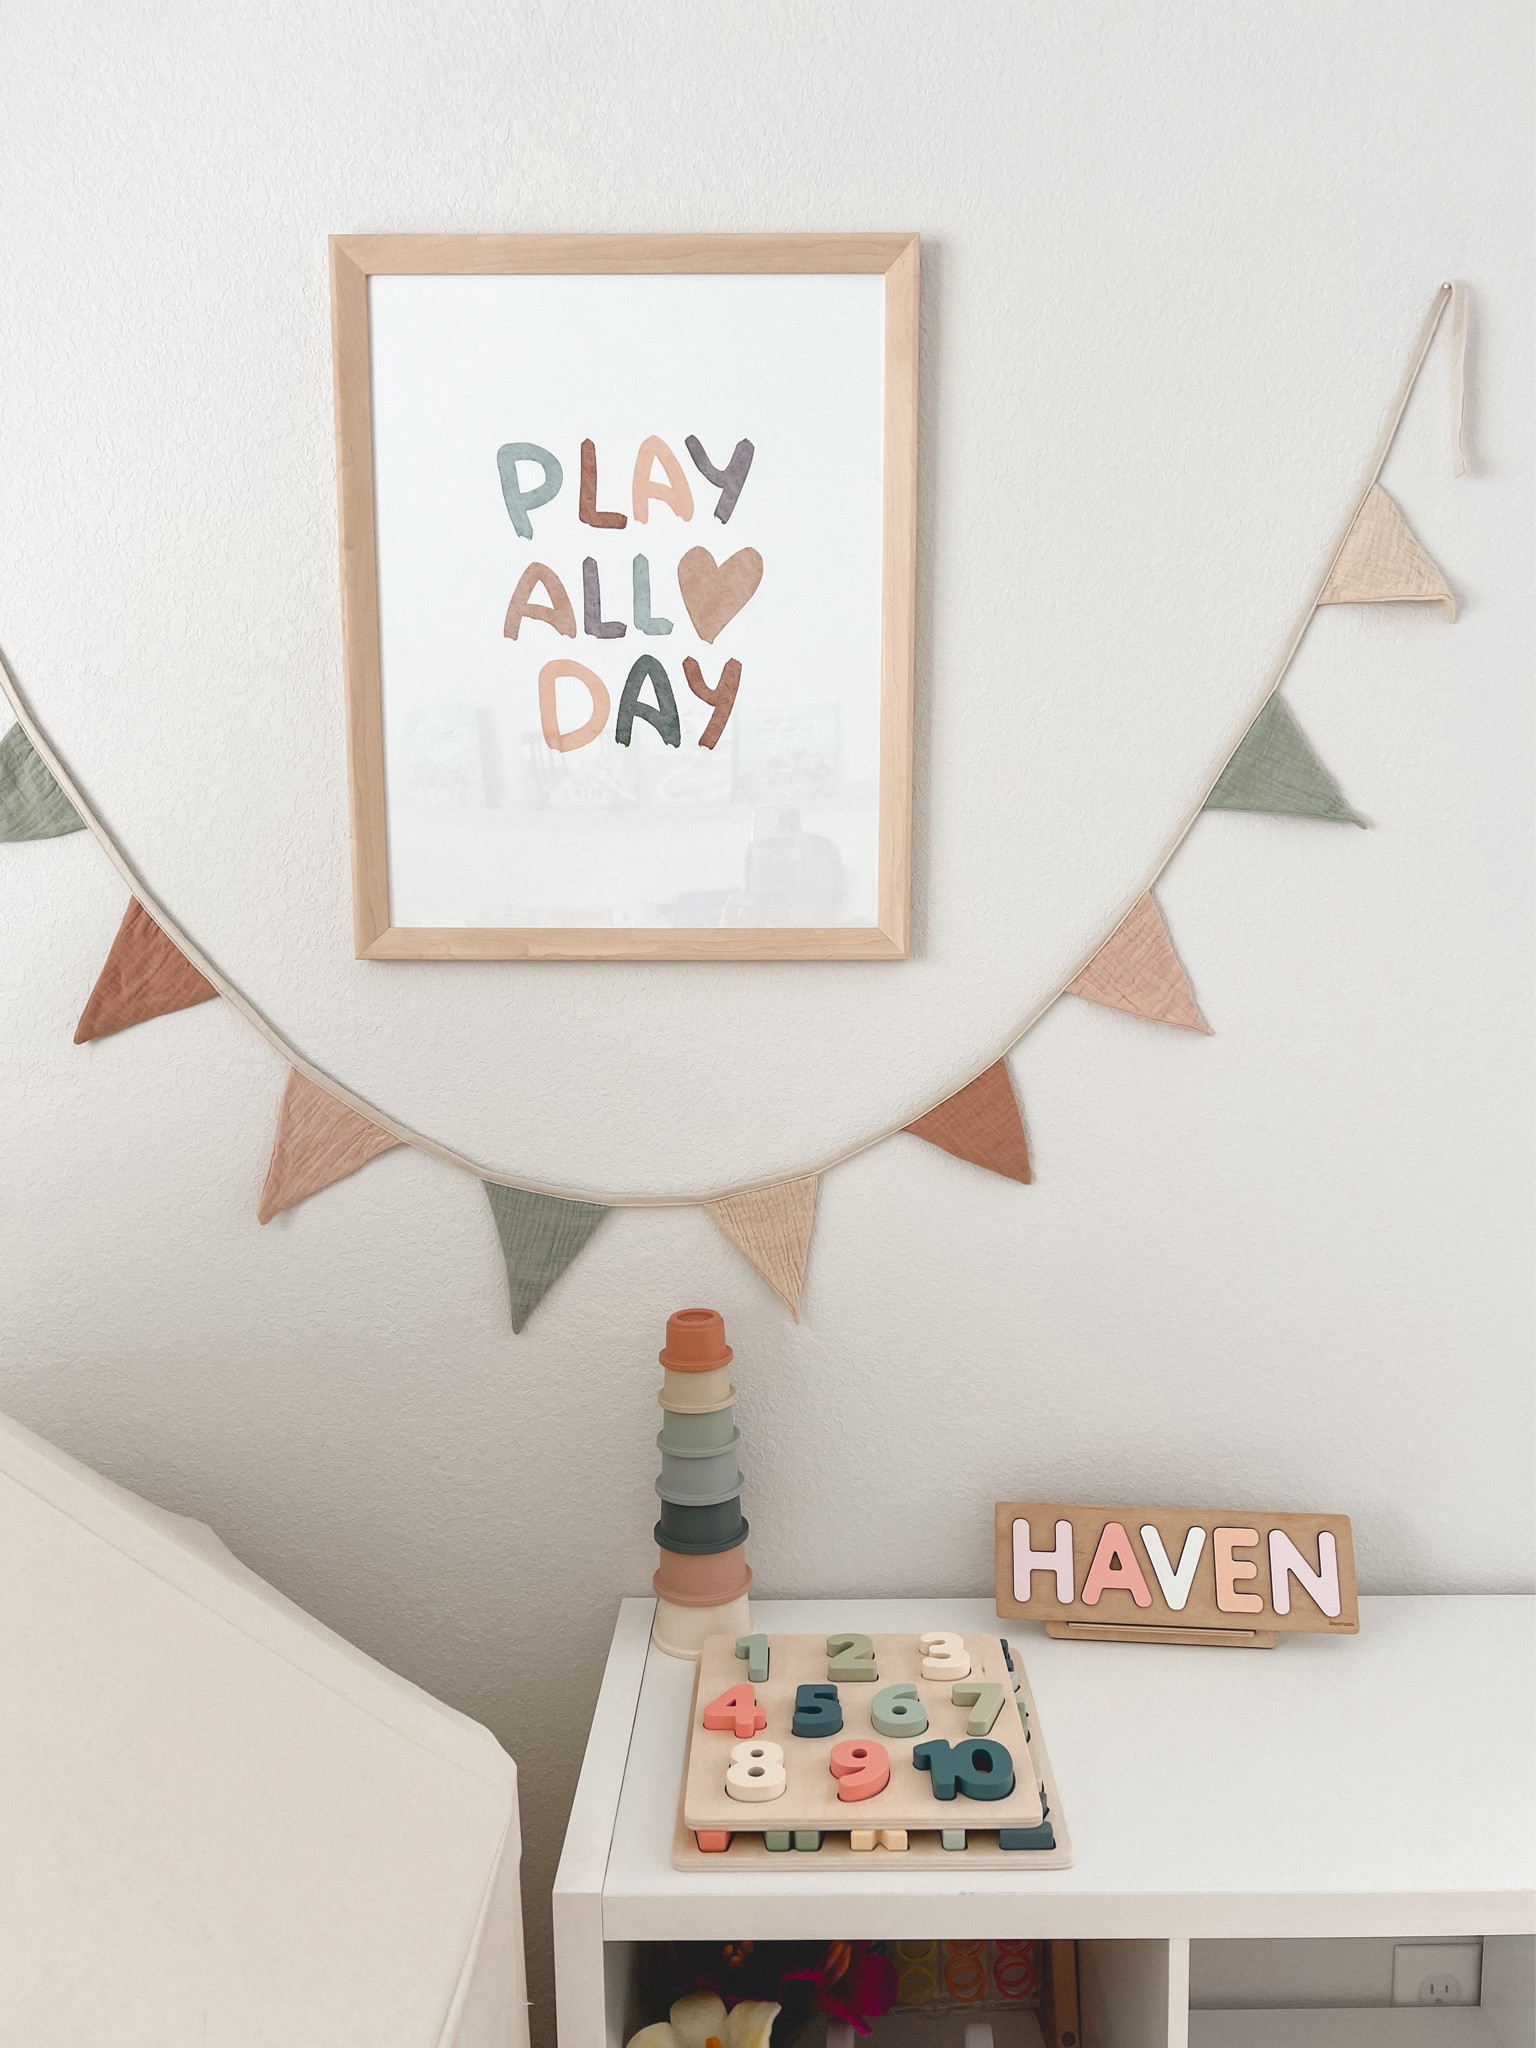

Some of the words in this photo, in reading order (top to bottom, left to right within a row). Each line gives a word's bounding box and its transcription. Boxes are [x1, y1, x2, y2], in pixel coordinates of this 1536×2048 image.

[497, 435, 755, 540] PLAY
[503, 553, 674, 641] ALL
[538, 654, 742, 753] DAY
[1012, 1517, 1341, 1618] HAVEN
[735, 1633, 769, 1682] 1
[826, 1632, 878, 1681] 2
[919, 1631, 971, 1680] 3
[703, 1683, 766, 1738] 4
[791, 1683, 843, 1737] 5
[871, 1683, 928, 1737] 6
[951, 1682, 1005, 1736] 7
[726, 1740, 786, 1802] 8
[829, 1739, 890, 1802] 9
[913, 1738, 1015, 1800] 10
